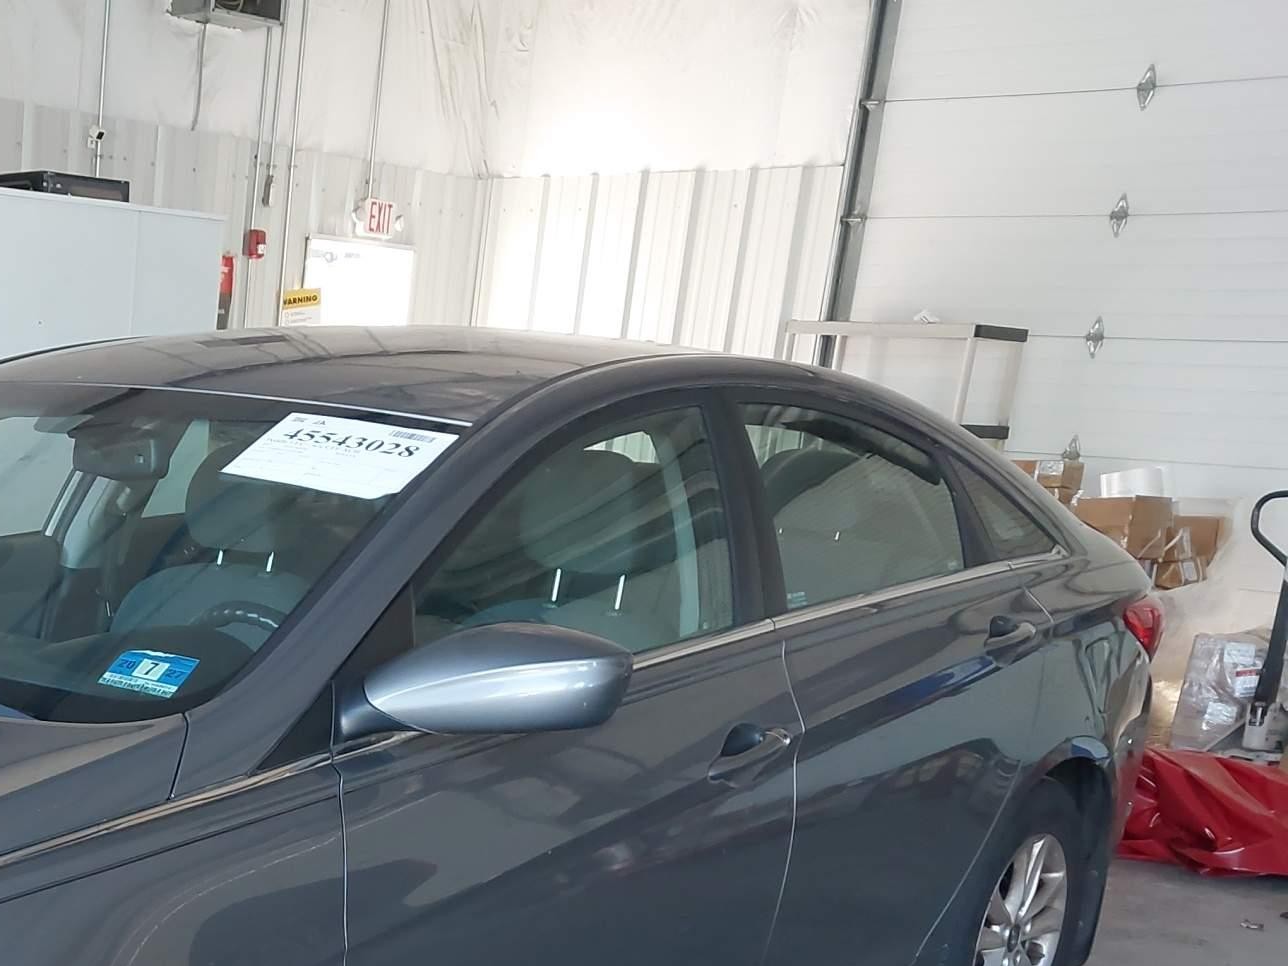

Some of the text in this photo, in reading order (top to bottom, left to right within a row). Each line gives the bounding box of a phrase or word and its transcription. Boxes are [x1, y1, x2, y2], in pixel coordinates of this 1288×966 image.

[368, 201, 393, 235] EXIT
[283, 428, 420, 458] 45543028
[144, 662, 159, 675] 7
